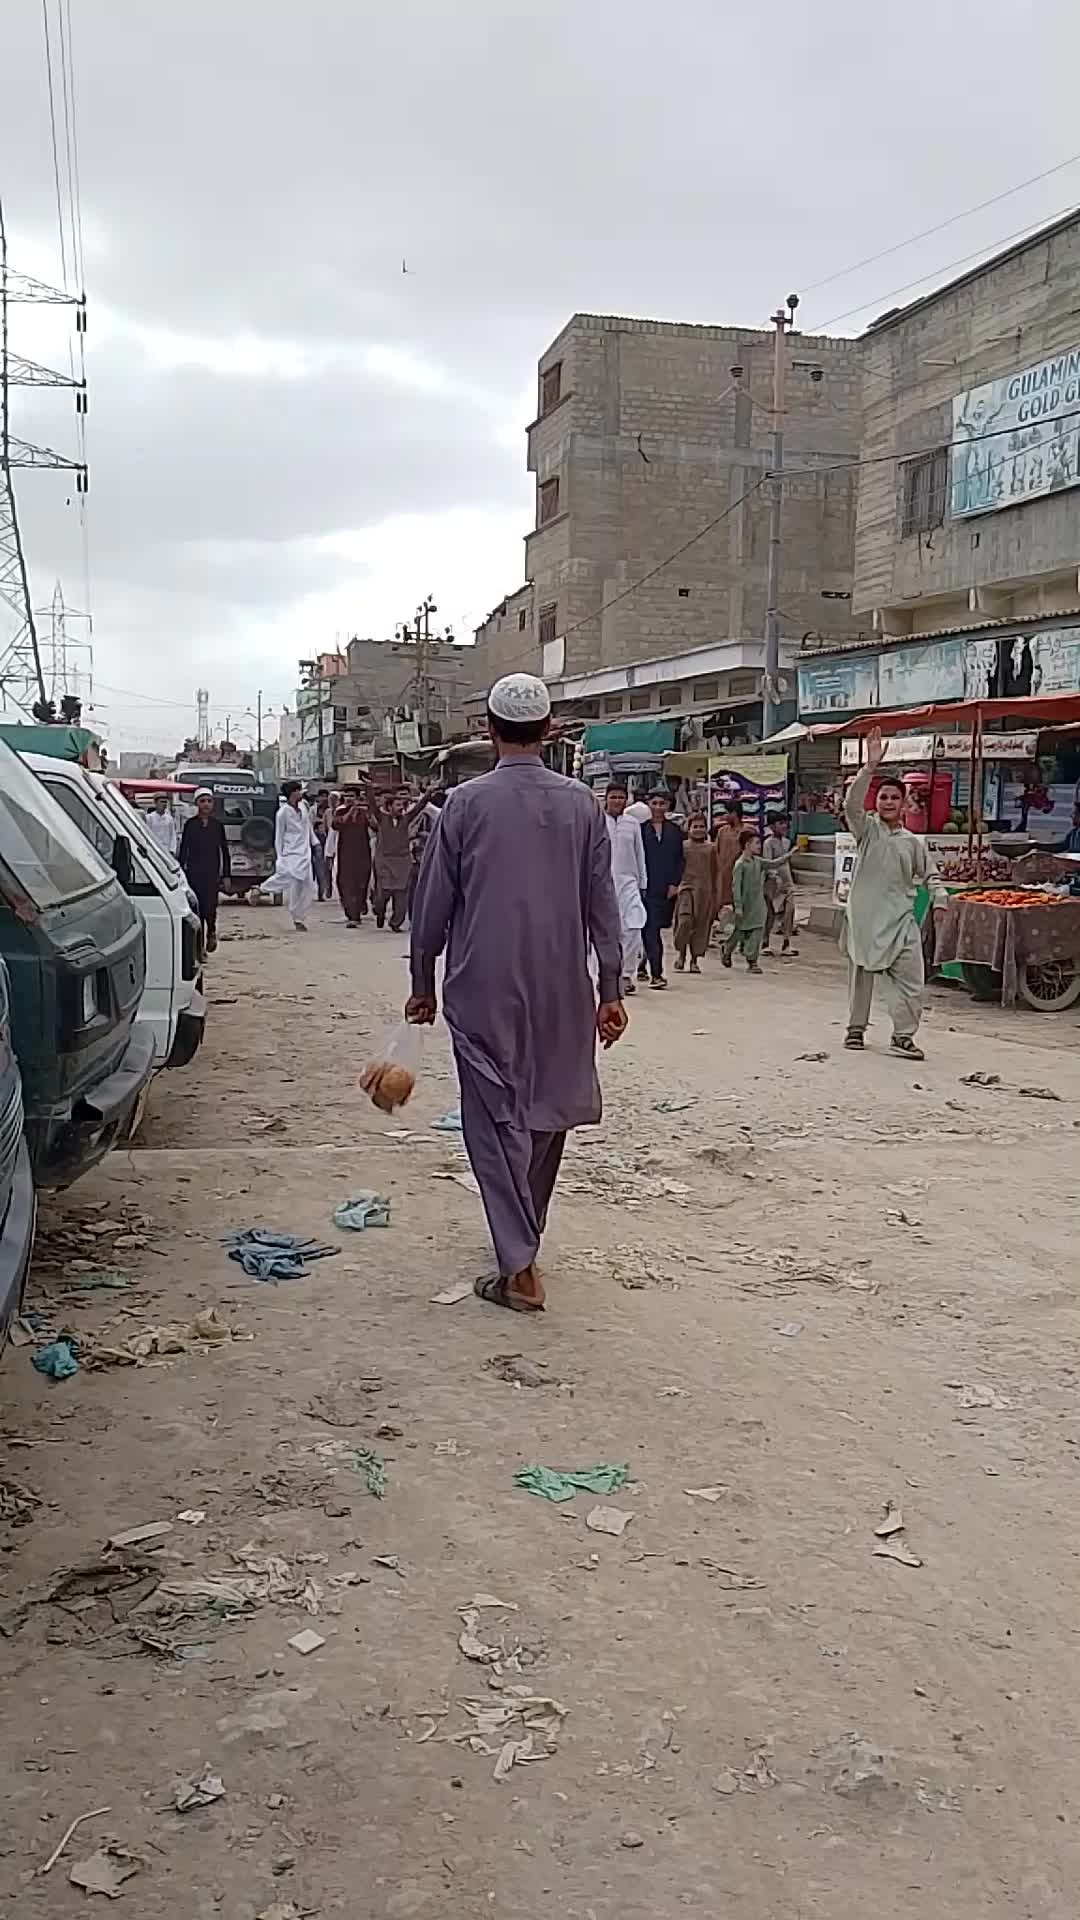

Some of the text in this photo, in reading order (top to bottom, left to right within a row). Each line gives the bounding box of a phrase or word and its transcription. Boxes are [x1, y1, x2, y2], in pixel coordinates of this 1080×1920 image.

[1008, 359, 1064, 400] GULAM
[1018, 389, 1060, 423] GOLD
[213, 784, 265, 795] ROZGAR
